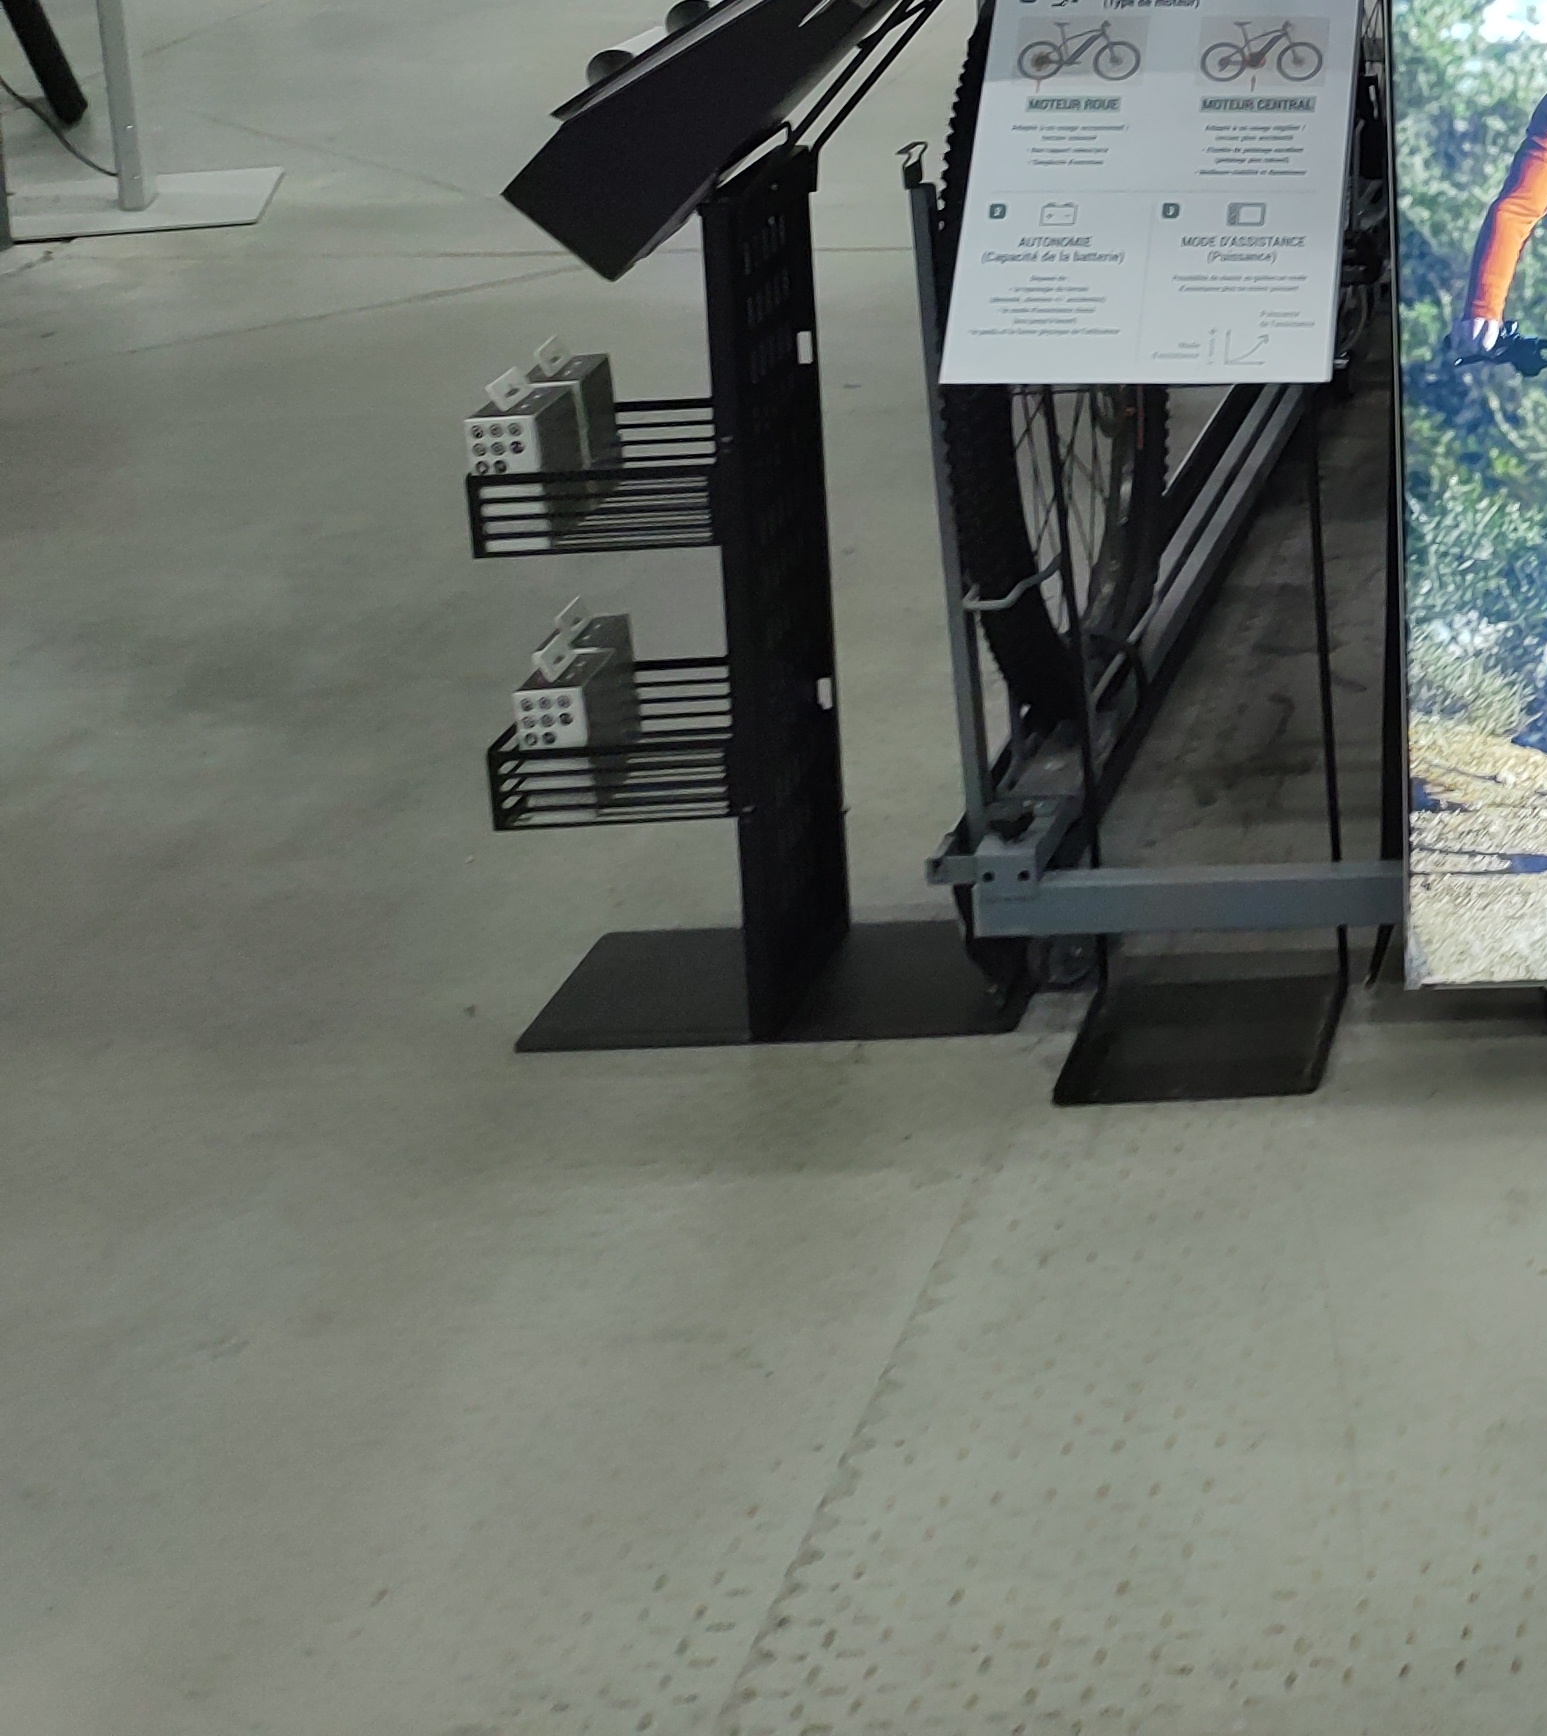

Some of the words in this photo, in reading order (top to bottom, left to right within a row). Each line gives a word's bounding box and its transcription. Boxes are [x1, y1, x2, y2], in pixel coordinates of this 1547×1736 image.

[1028, 98, 1081, 110] MOTEUR
[1202, 98, 1254, 110] MOTEUR
[1257, 98, 1312, 110] CENTRAL
[1018, 235, 1094, 248] AUTONOMIE
[1180, 235, 1216, 248] MODE
[1219, 235, 1307, 248] D'ASSISTANCE
[980, 250, 1038, 265] (Capacité
[1041, 251, 1055, 262] de
[1058, 251, 1070, 262] la
[1072, 250, 1126, 265] batterie)
[1207, 250, 1278, 265] (Puissance)
